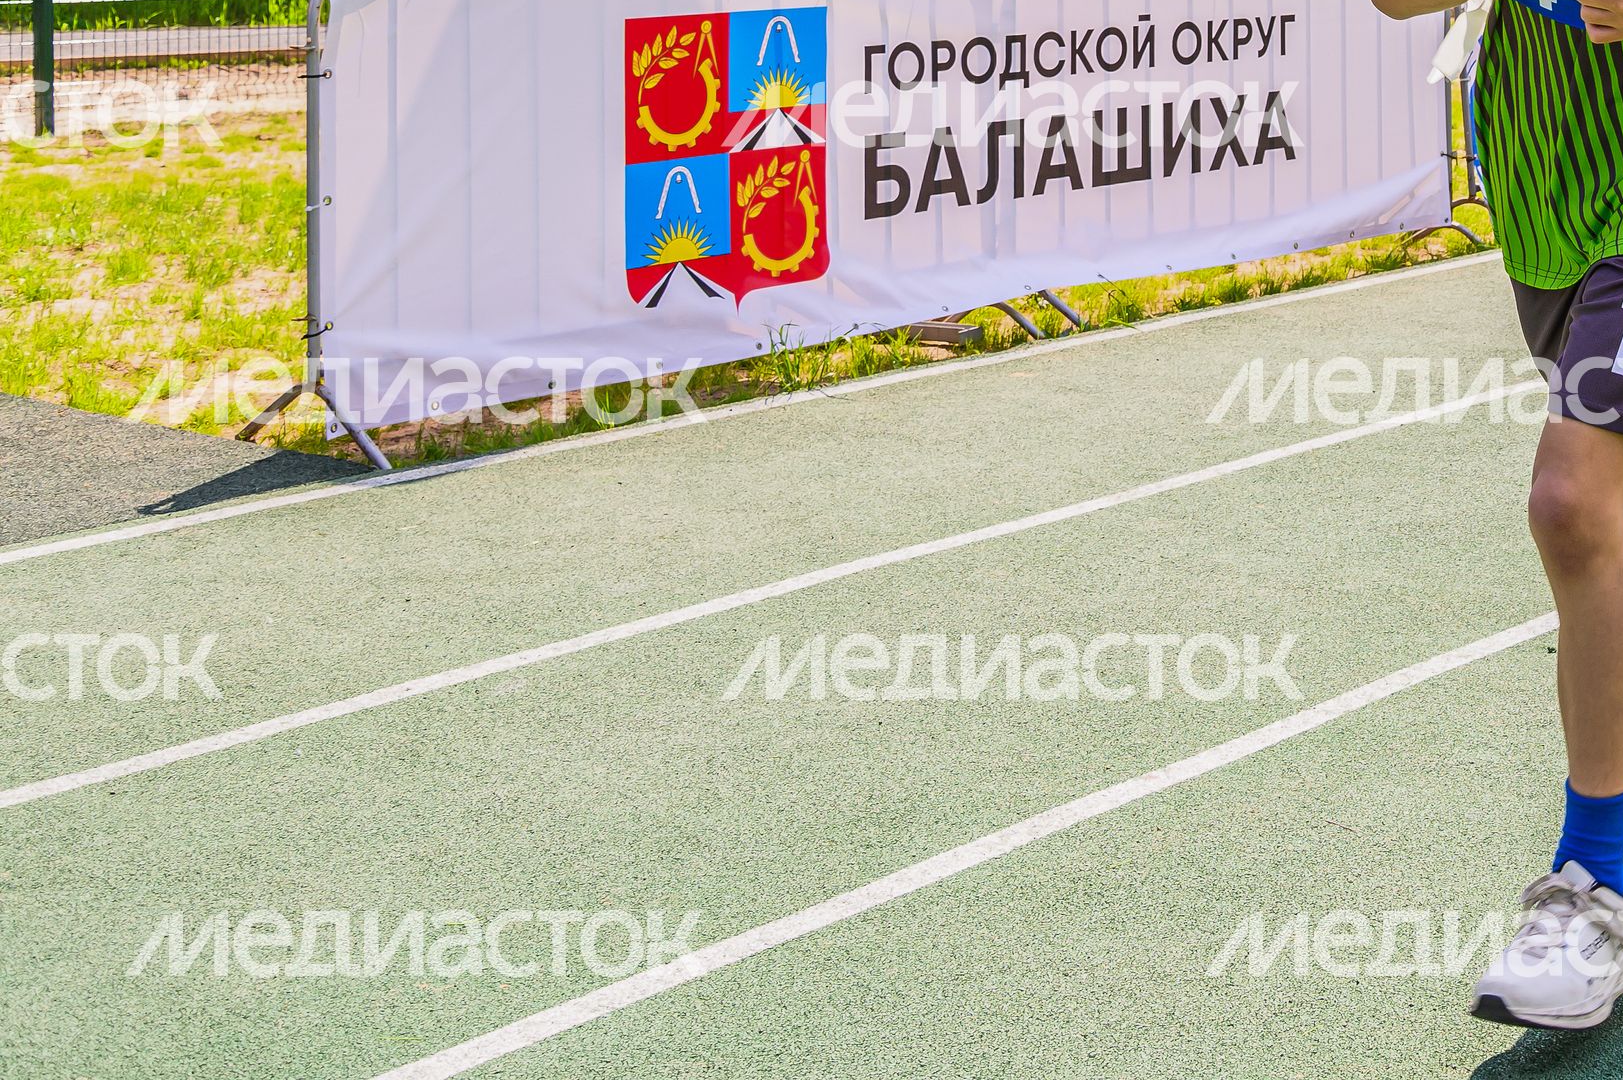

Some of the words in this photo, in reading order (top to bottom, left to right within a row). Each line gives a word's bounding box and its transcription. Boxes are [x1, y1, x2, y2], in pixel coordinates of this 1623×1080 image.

[864, 14, 1155, 94] ГОРОДСКОЙ
[1173, 14, 1296, 66] ОКРУГ
[864, 90, 1297, 220] БАЛАШИХА
